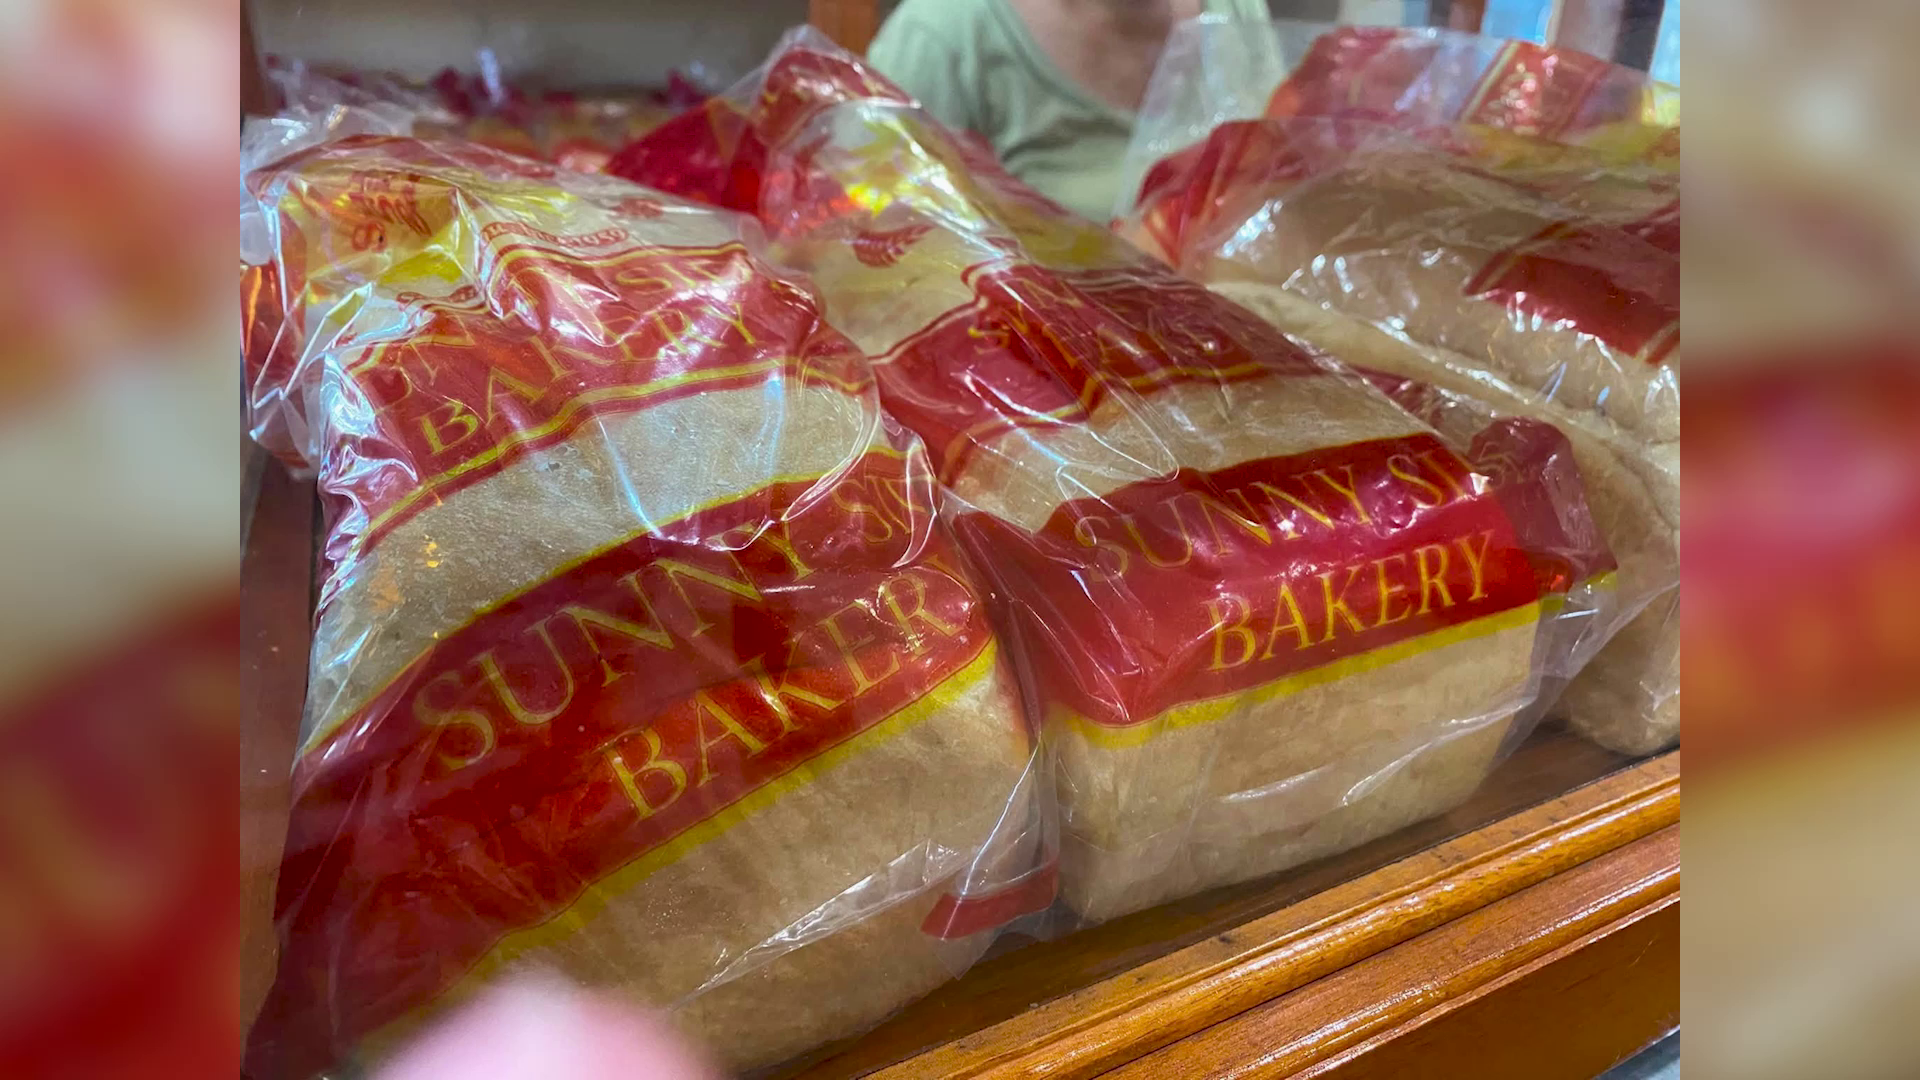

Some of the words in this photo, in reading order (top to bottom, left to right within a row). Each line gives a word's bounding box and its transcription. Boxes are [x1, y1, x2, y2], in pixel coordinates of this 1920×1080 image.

[1074, 464, 1373, 582] SUNNY
[412, 510, 817, 771] SUNNY
[1203, 529, 1497, 672] BAKERY
